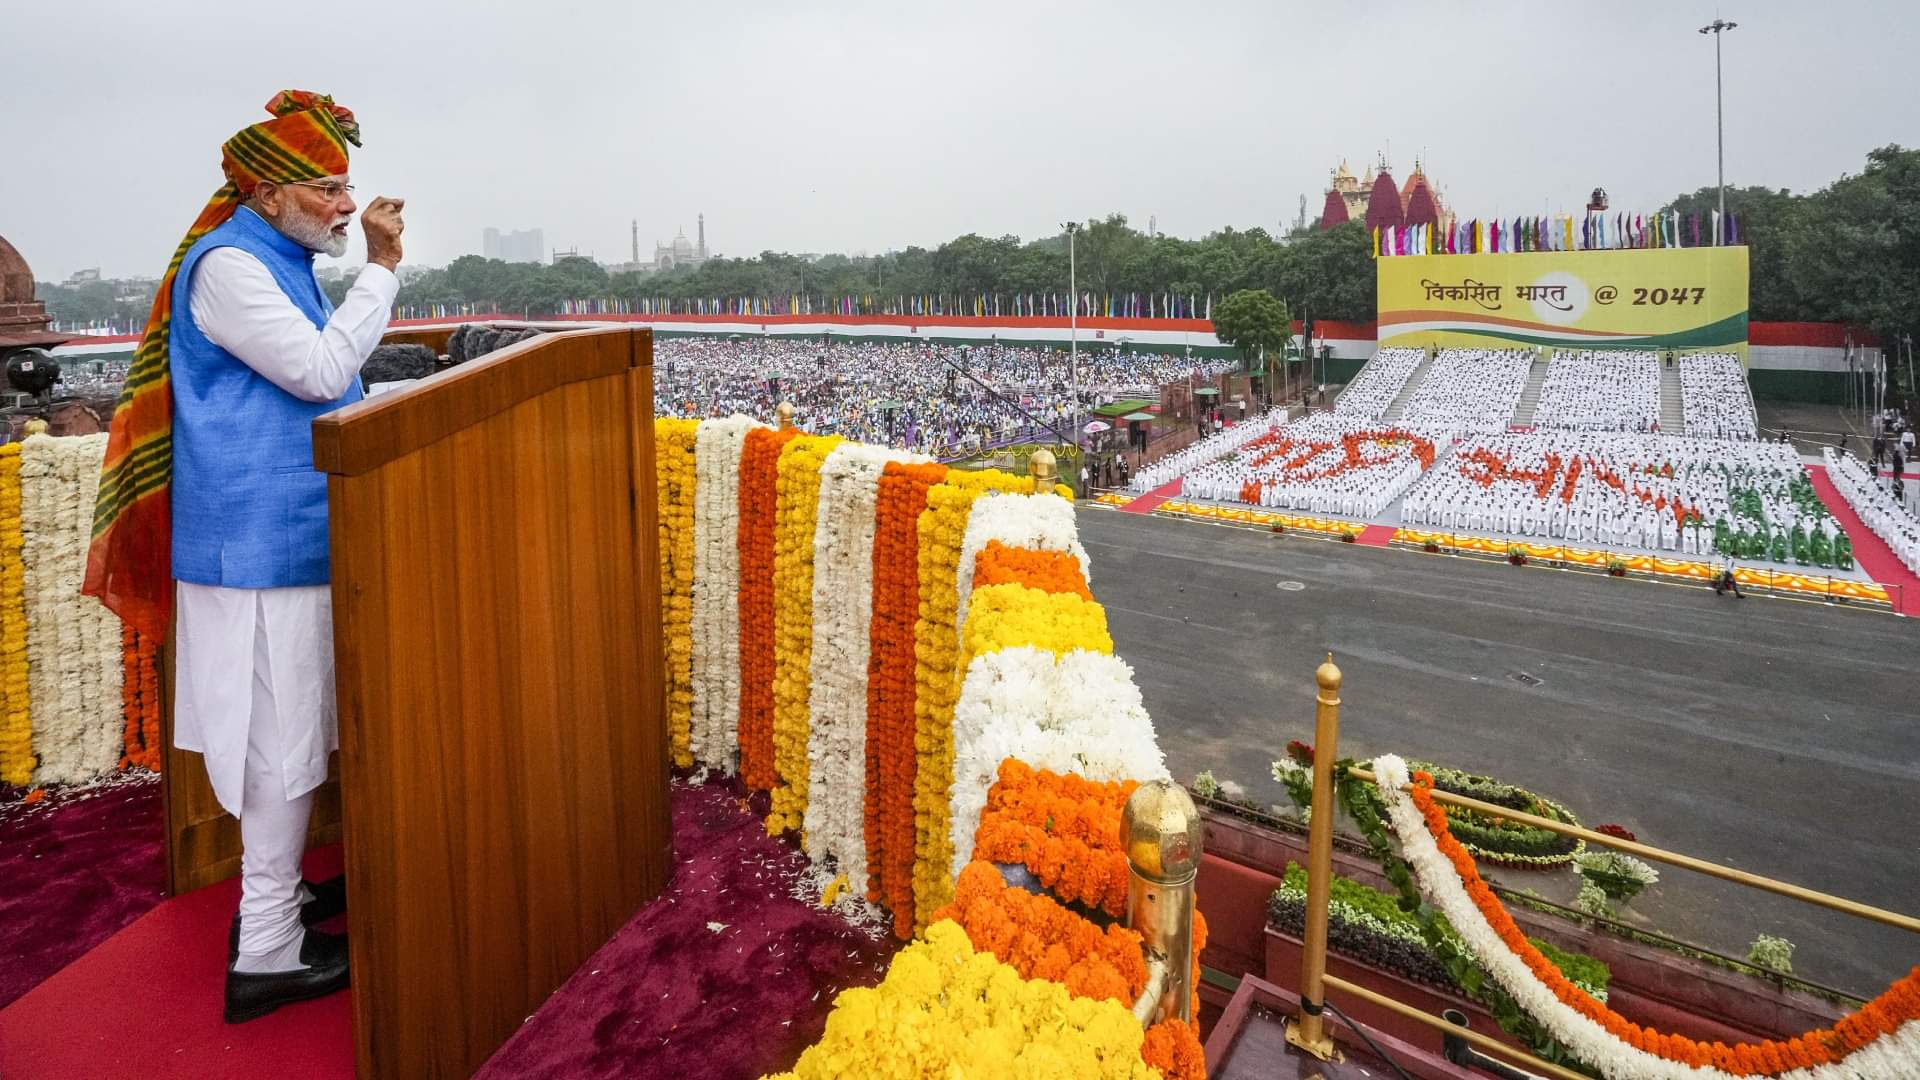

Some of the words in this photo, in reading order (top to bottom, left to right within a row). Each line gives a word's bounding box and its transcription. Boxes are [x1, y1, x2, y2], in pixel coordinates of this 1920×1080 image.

[1516, 286, 1573, 311] भारत
[1594, 285, 1618, 305] @
[1632, 287, 1706, 306] 2047
